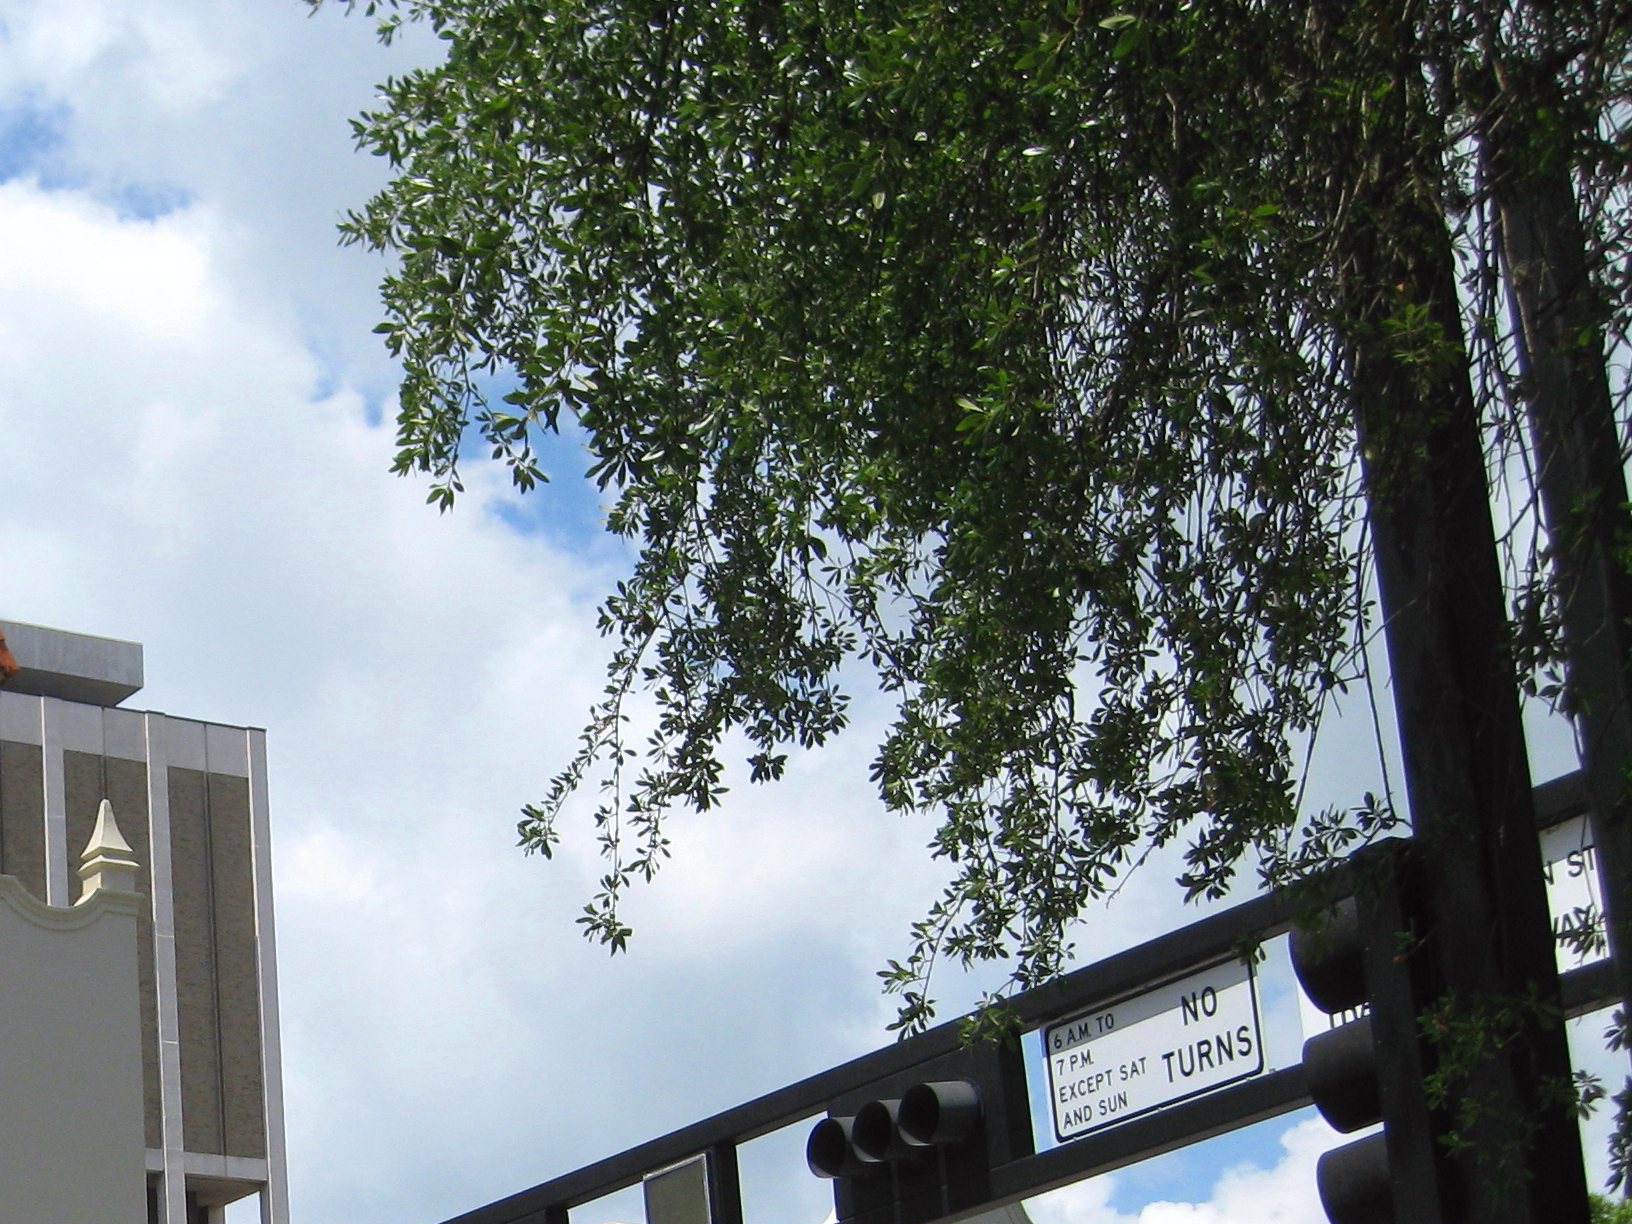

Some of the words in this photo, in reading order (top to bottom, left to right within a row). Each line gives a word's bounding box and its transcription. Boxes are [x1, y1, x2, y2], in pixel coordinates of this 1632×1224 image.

[1180, 986, 1218, 1026] NO
[1053, 1033, 1063, 1049] 6
[1097, 1013, 1115, 1033] TO
[1056, 1058, 1065, 1077] 7
[1161, 1025, 1253, 1083] TURNS
[1058, 1069, 1112, 1104] EXCEPT
[1119, 1056, 1147, 1082] SAT
[1063, 1105, 1093, 1130] AND
[1099, 1091, 1129, 1117] SUN
